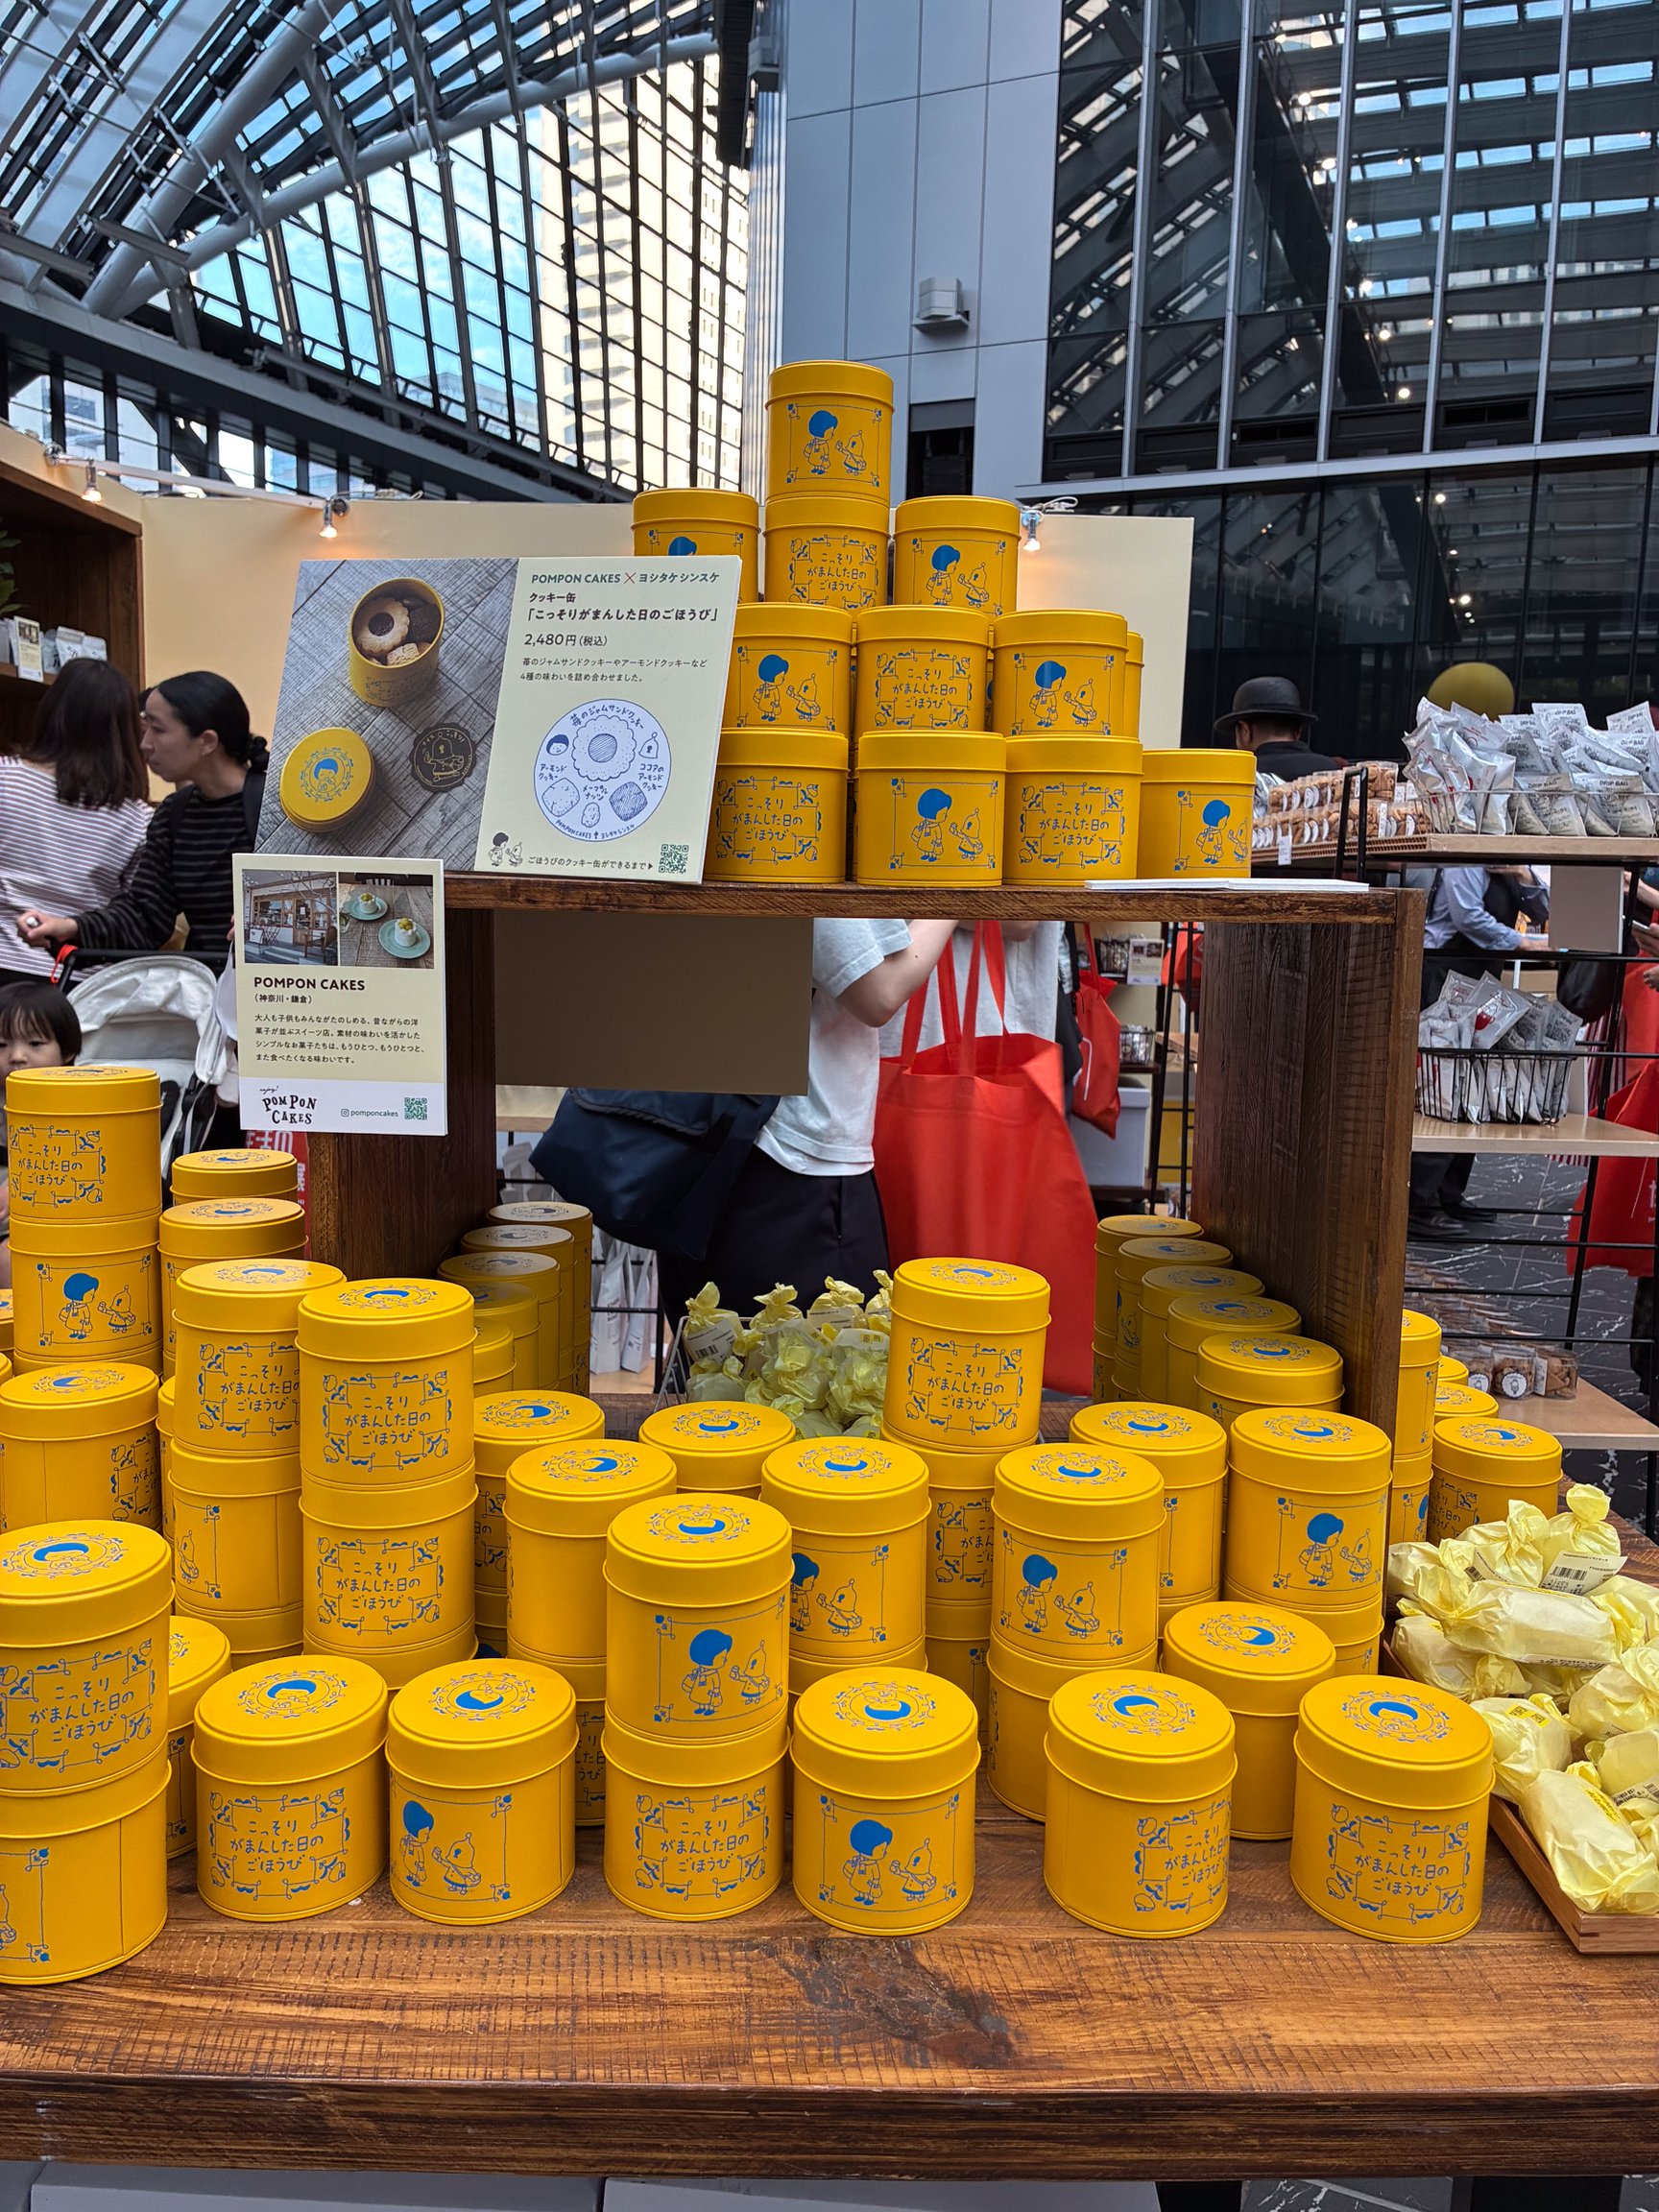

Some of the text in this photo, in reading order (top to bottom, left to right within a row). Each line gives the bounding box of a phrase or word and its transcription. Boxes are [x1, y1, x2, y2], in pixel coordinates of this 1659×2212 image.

[821, 551, 854, 566] こっそり
[531, 574, 582, 584] POMPON
[584, 573, 621, 584] CAKES
[638, 572, 720, 584] ヨシタケシンスケ
[806, 565, 868, 580] がまんした日の
[819, 580, 856, 592] ごほうび
[529, 592, 576, 603] クッキー缶
[528, 608, 718, 621] 「こっそりがまんした日のごほうび」
[522, 658, 709, 668] 苺のジャムサンドクッキーやアーモンドクッキーなど
[520, 672, 643, 683] 4種の味わいを詰め合わせました。
[907, 668, 943, 681] こっそり
[892, 684, 957, 696] がまんした日の
[905, 697, 945, 709] ごほうび
[747, 797, 784, 810] こっそり
[1056, 803, 1093, 816] こっそり
[732, 814, 804, 827] がまんした日の
[1039, 818, 1109, 831] がまんした日の
[744, 829, 788, 842] ごほうび
[1052, 833, 1097, 846] ごほうび
[528, 856, 646, 870] ごほうびのクッキー缶ができるまで
[253, 976, 366, 991] POMPON CAKES
[255, 1053, 355, 1064] また食べたくなる味わいです。
[272, 1110, 312, 1124] CAKES
[350, 1110, 399, 1118] pomponcakes
[29, 1143, 60, 1158] こっそり
[18, 1158, 83, 1172] がまんした日の
[28, 1171, 68, 1186] ごほうび
[240, 1364, 283, 1379] こっそり
[946, 1362, 986, 1378] こっそり
[927, 1377, 1004, 1396] がまんした日の
[237, 1397, 289, 1412] ごほうび
[364, 1395, 409, 1409] こっそり
[941, 1395, 990, 1410] ごほうび
[344, 1411, 432, 1429] がまんした日の
[361, 1429, 415, 1446] ごほうび
[353, 1562, 397, 1575] こっそり
[336, 1577, 421, 1593] がまんした日の
[351, 1595, 404, 1610] ごほうび
[55, 1677, 109, 1700] こっそり
[29, 1691, 134, 1724] がまんした日の
[52, 1713, 117, 1743] ごほうび
[249, 1820, 297, 1837] こっそり
[681, 1820, 728, 1836] こっそり
[229, 1836, 325, 1854] がまんした日の
[661, 1834, 750, 1854] がまんした日の
[1377, 1840, 1427, 1860] こっそり
[247, 1854, 306, 1873] ごほうび
[678, 1853, 734, 1873] ごほうび
[1355, 1854, 1450, 1880] がまんした日の
[1372, 1879, 1432, 1896] ごほうび
